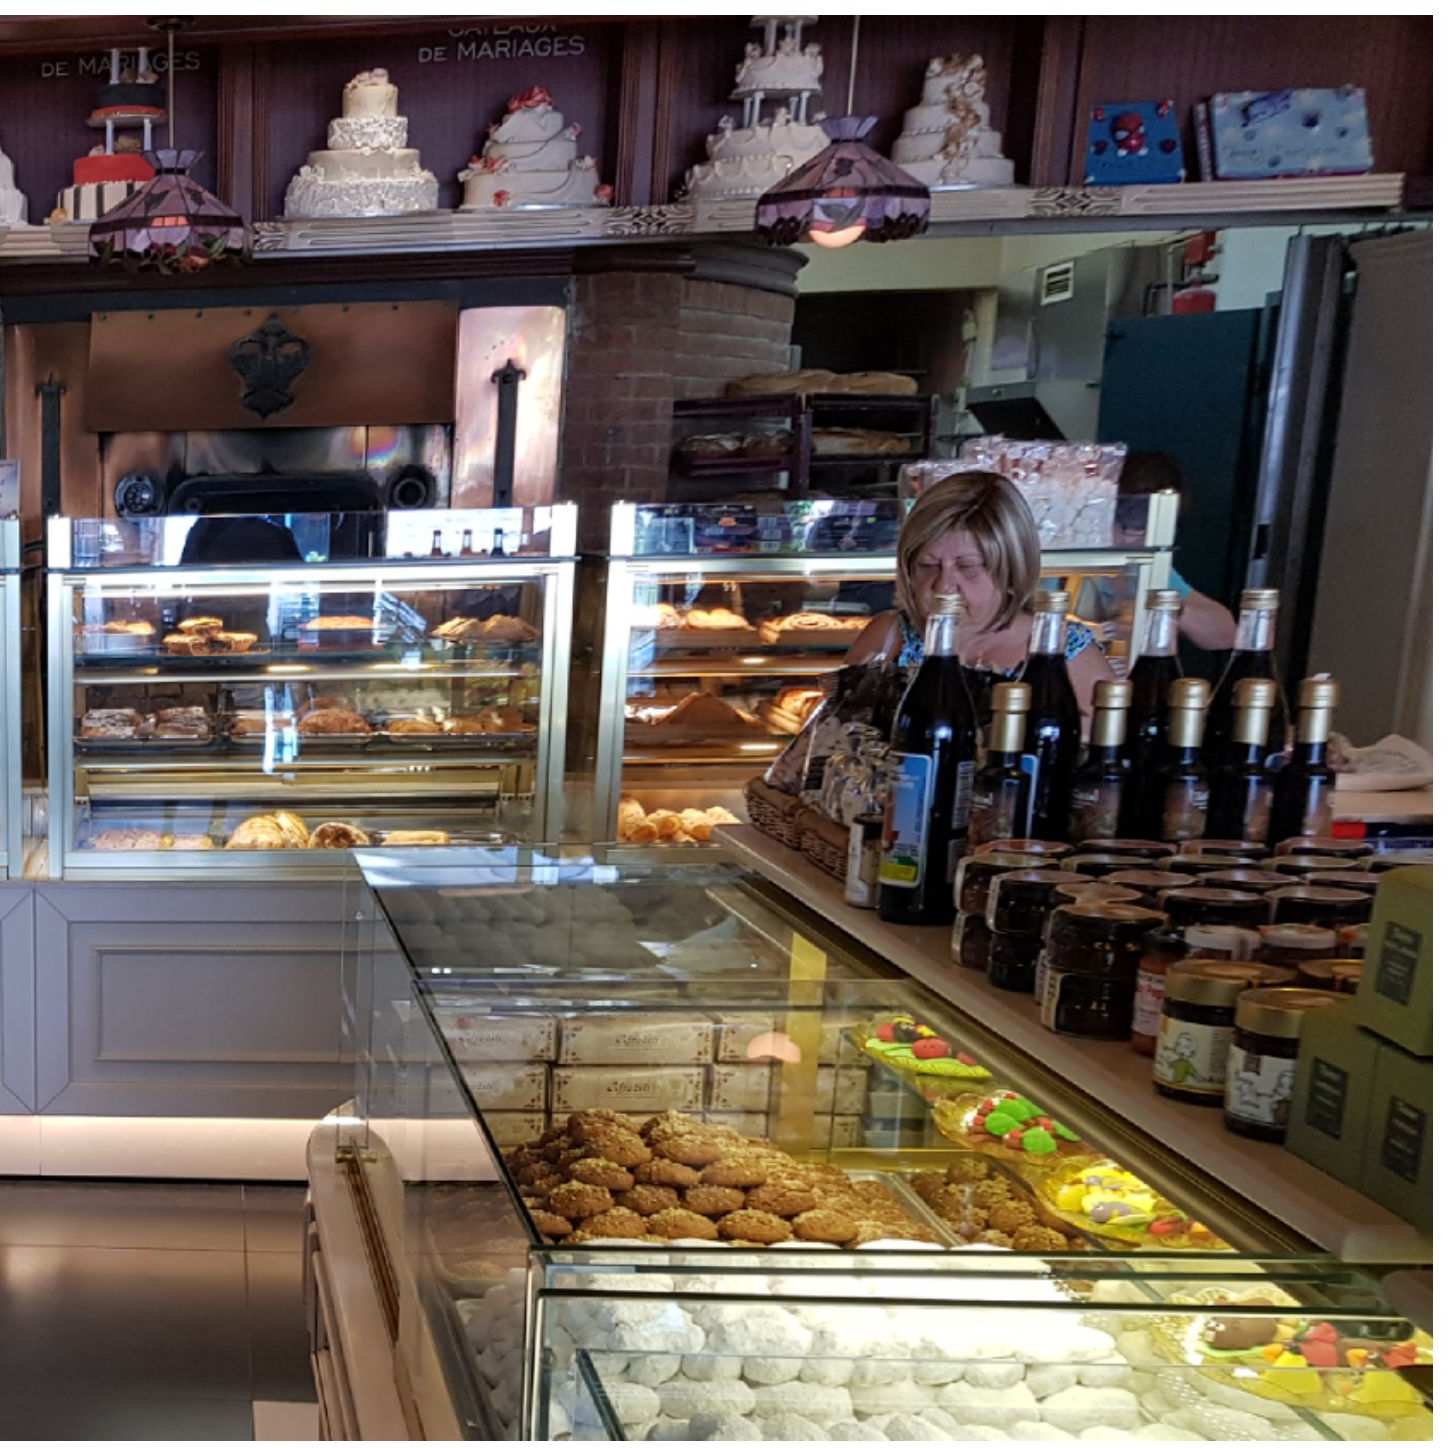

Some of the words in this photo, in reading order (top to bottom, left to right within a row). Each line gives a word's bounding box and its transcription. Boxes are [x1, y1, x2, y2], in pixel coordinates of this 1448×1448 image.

[418, 47, 448, 63] DE
[457, 35, 586, 61] MARIAGES
[40, 61, 69, 78] DE
